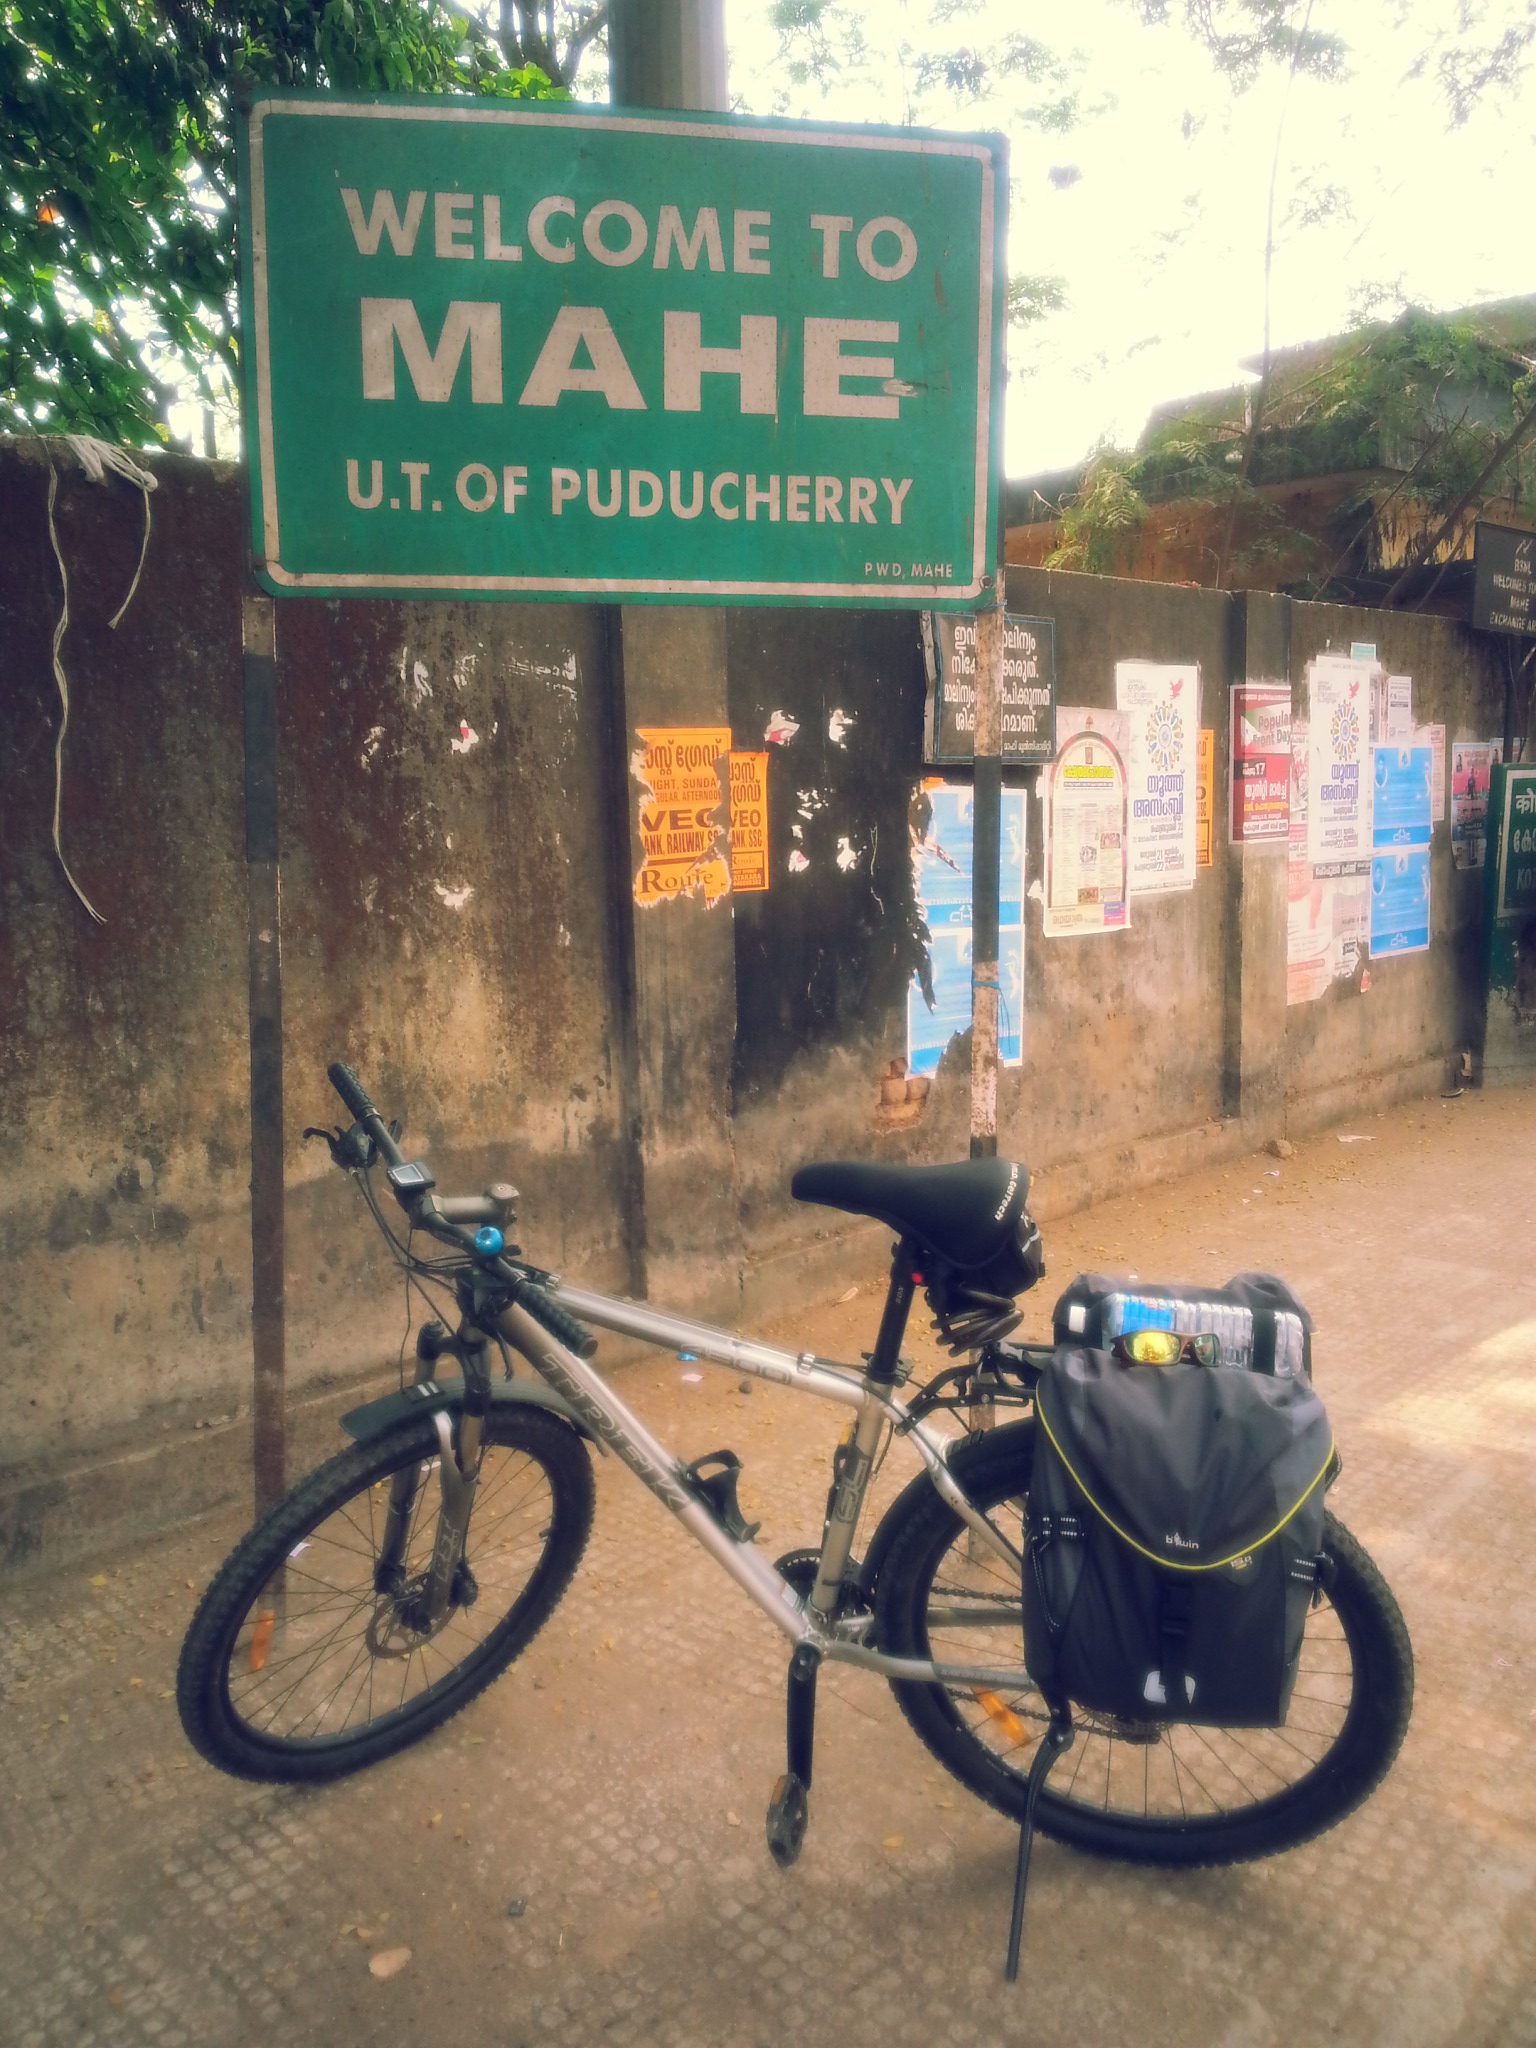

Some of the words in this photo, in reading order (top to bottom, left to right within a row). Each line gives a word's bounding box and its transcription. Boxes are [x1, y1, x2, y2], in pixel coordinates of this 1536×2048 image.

[340, 187, 771, 275] WELCOME
[810, 213, 918, 281] TO
[361, 297, 899, 419] MAHE
[347, 459, 442, 511] U.T.
[455, 462, 528, 514] OF
[550, 467, 912, 525] PUDUCHERRY
[910, 562, 953, 578] MAHE
[541, 1352, 691, 1514] TREK
